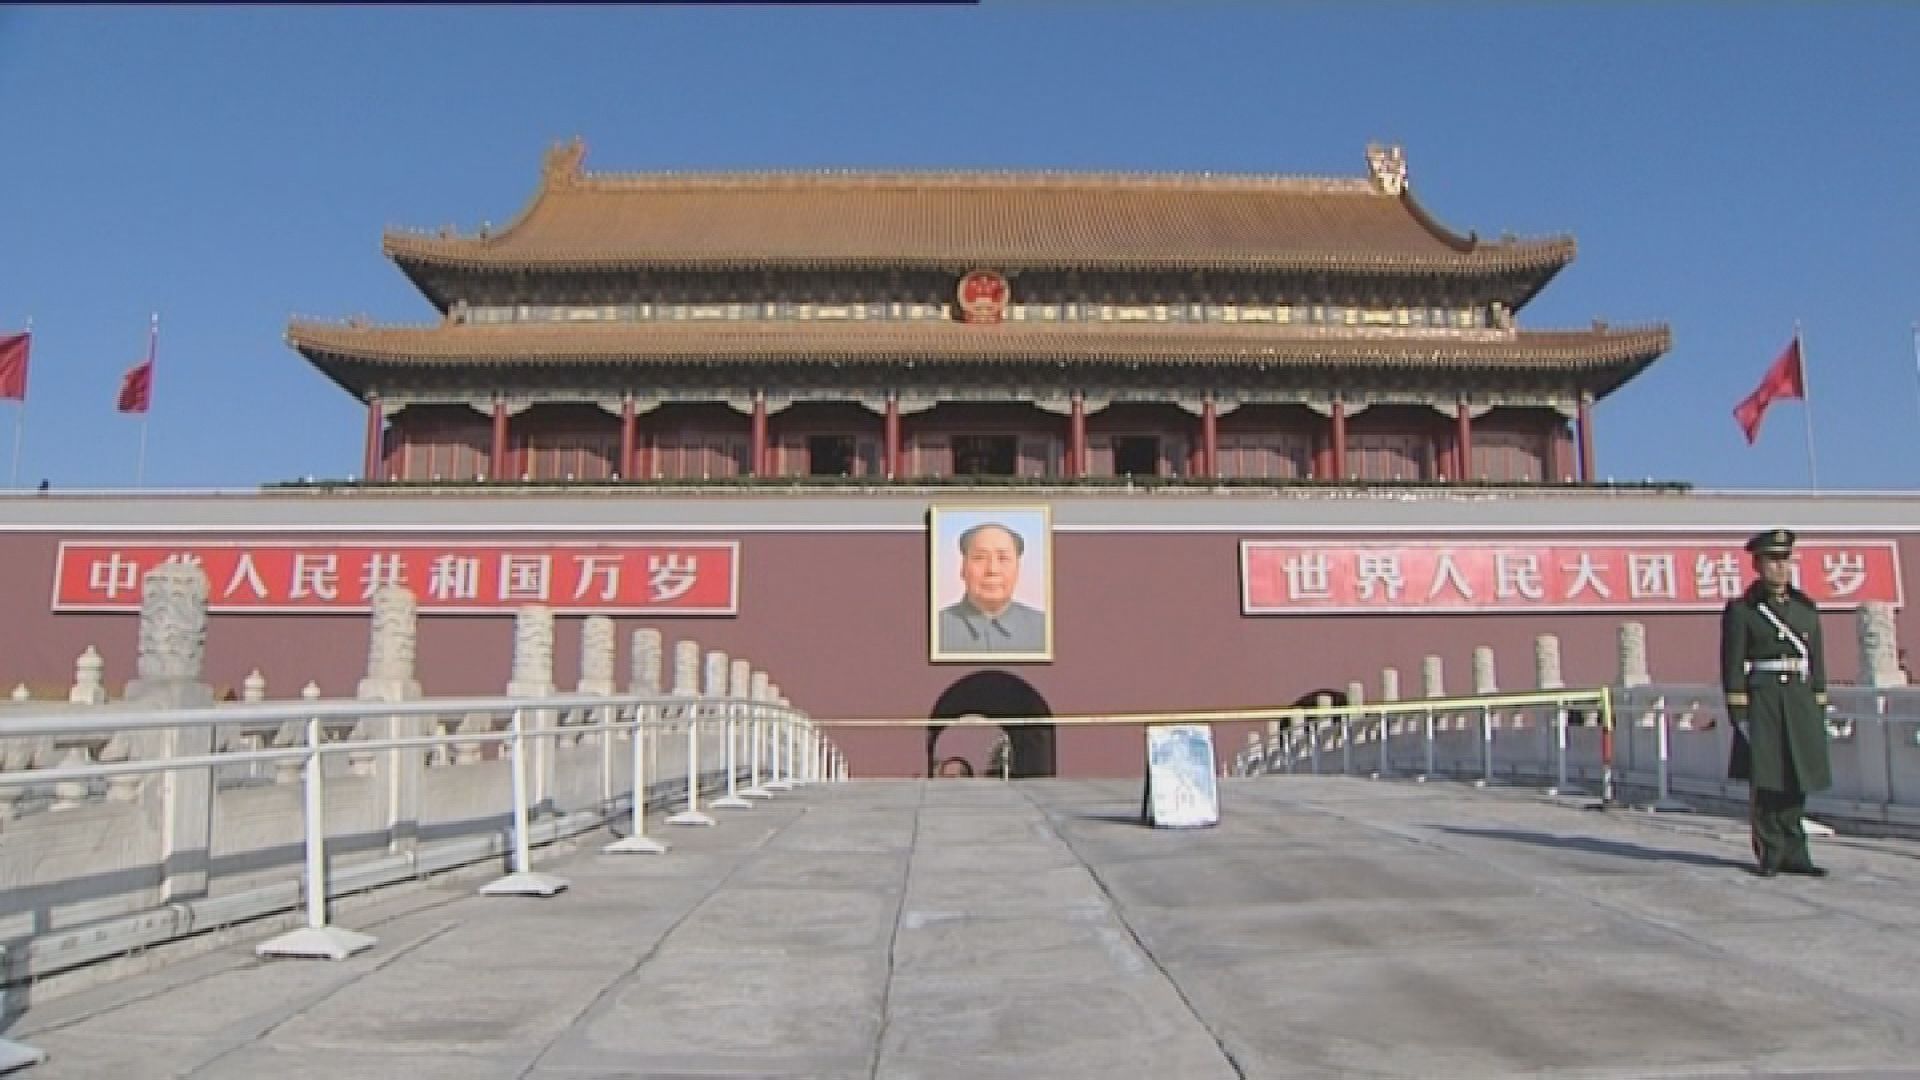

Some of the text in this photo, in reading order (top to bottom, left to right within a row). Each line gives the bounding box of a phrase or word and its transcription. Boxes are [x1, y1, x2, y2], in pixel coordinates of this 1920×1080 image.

[90, 552, 697, 601] 中人民共和国万岁
[1281, 551, 1866, 600] 世界人民大团结岁
